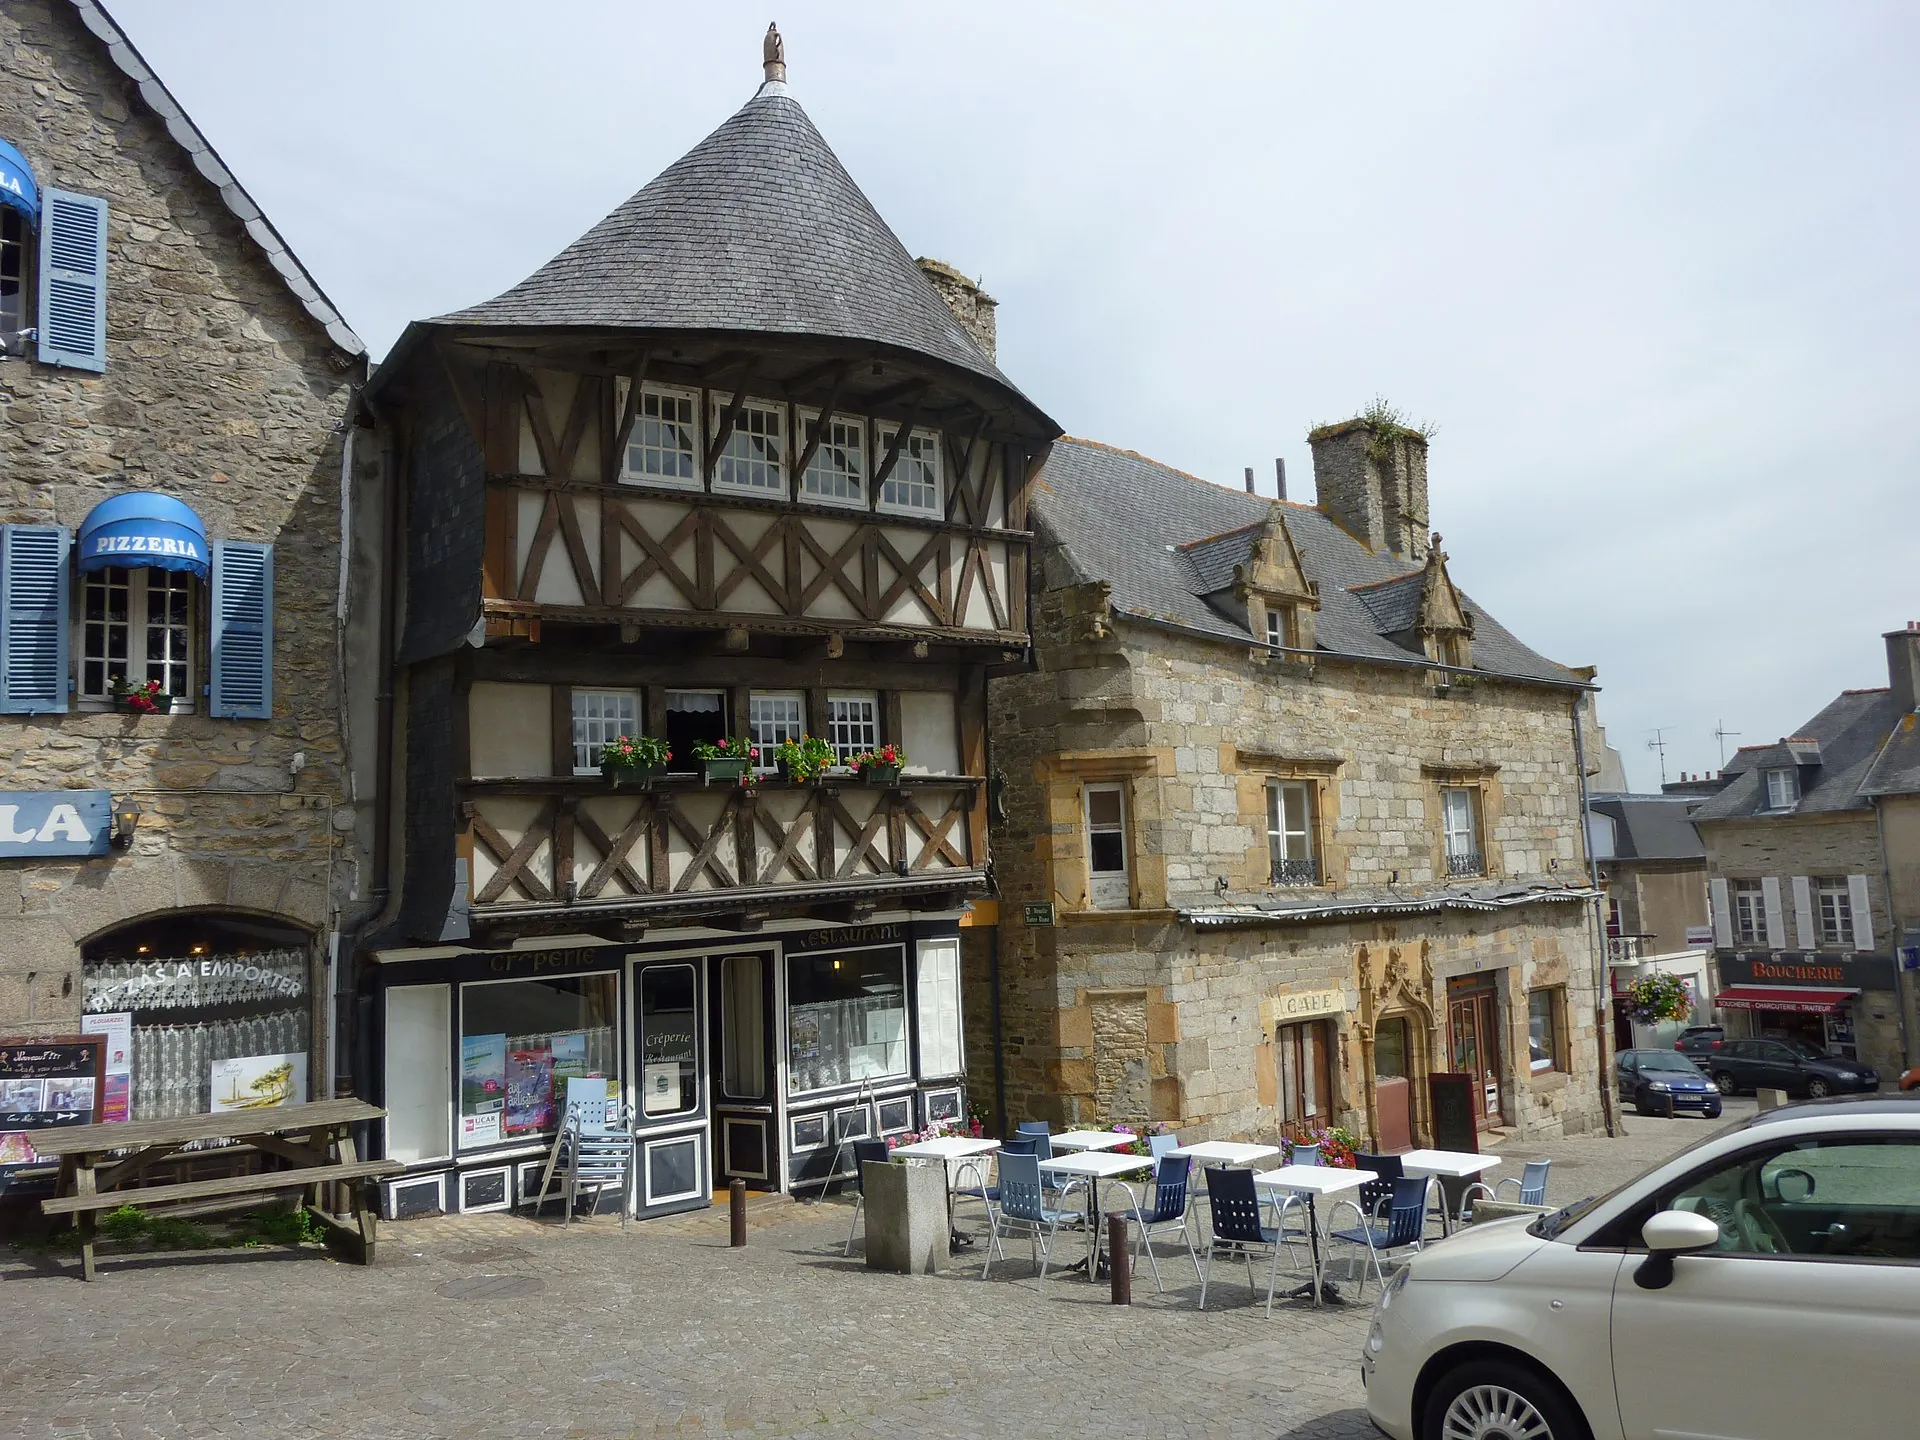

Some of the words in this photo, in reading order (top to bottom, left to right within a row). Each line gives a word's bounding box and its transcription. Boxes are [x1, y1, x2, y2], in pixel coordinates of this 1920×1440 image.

[96, 536, 198, 558] PIZZERIA
[0, 804, 91, 842] LA
[801, 922, 901, 948] estaurant
[490, 948, 595, 972] Crperie
[200, 961, 301, 998] EMPORTER
[1752, 961, 1843, 980] BOUCHERIE
[1718, 1001, 1750, 1009] BOUCHERIE
[1755, 1002, 1796, 1011] CHARCUTERIE
[1801, 1004, 1831, 1012] TRAITEUR
[646, 1033, 691, 1047] Crêperie
[645, 1049, 691, 1063] Restaurant
[475, 1116, 496, 1124] UCAR
